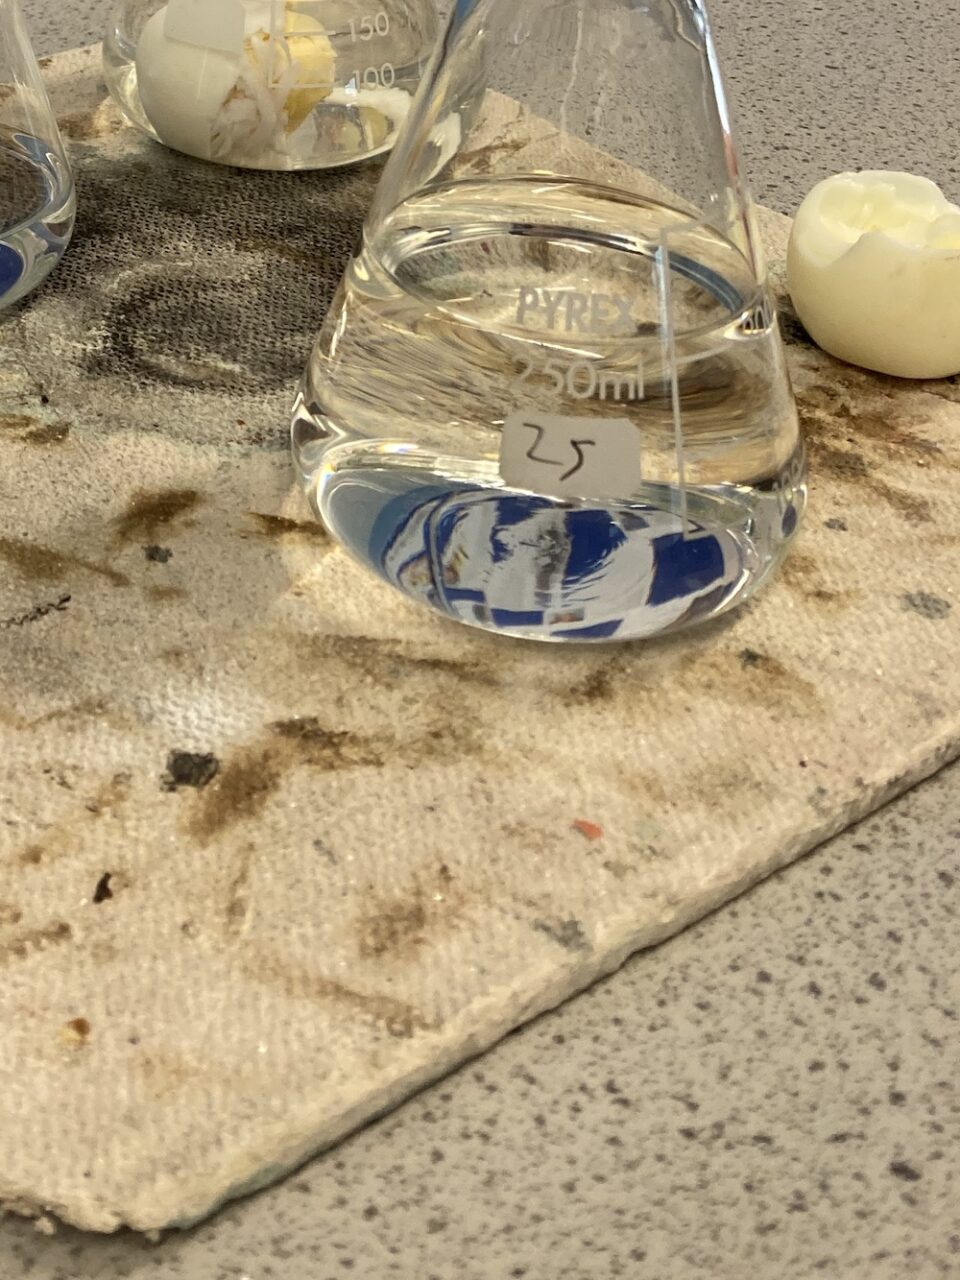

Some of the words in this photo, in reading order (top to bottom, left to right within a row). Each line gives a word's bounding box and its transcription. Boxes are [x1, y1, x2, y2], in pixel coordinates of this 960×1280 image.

[347, 12, 390, 43] 150
[352, 62, 395, 93] 100
[516, 285, 634, 334] PYREX
[511, 354, 645, 401] 250ml
[522, 422, 596, 481] 25
